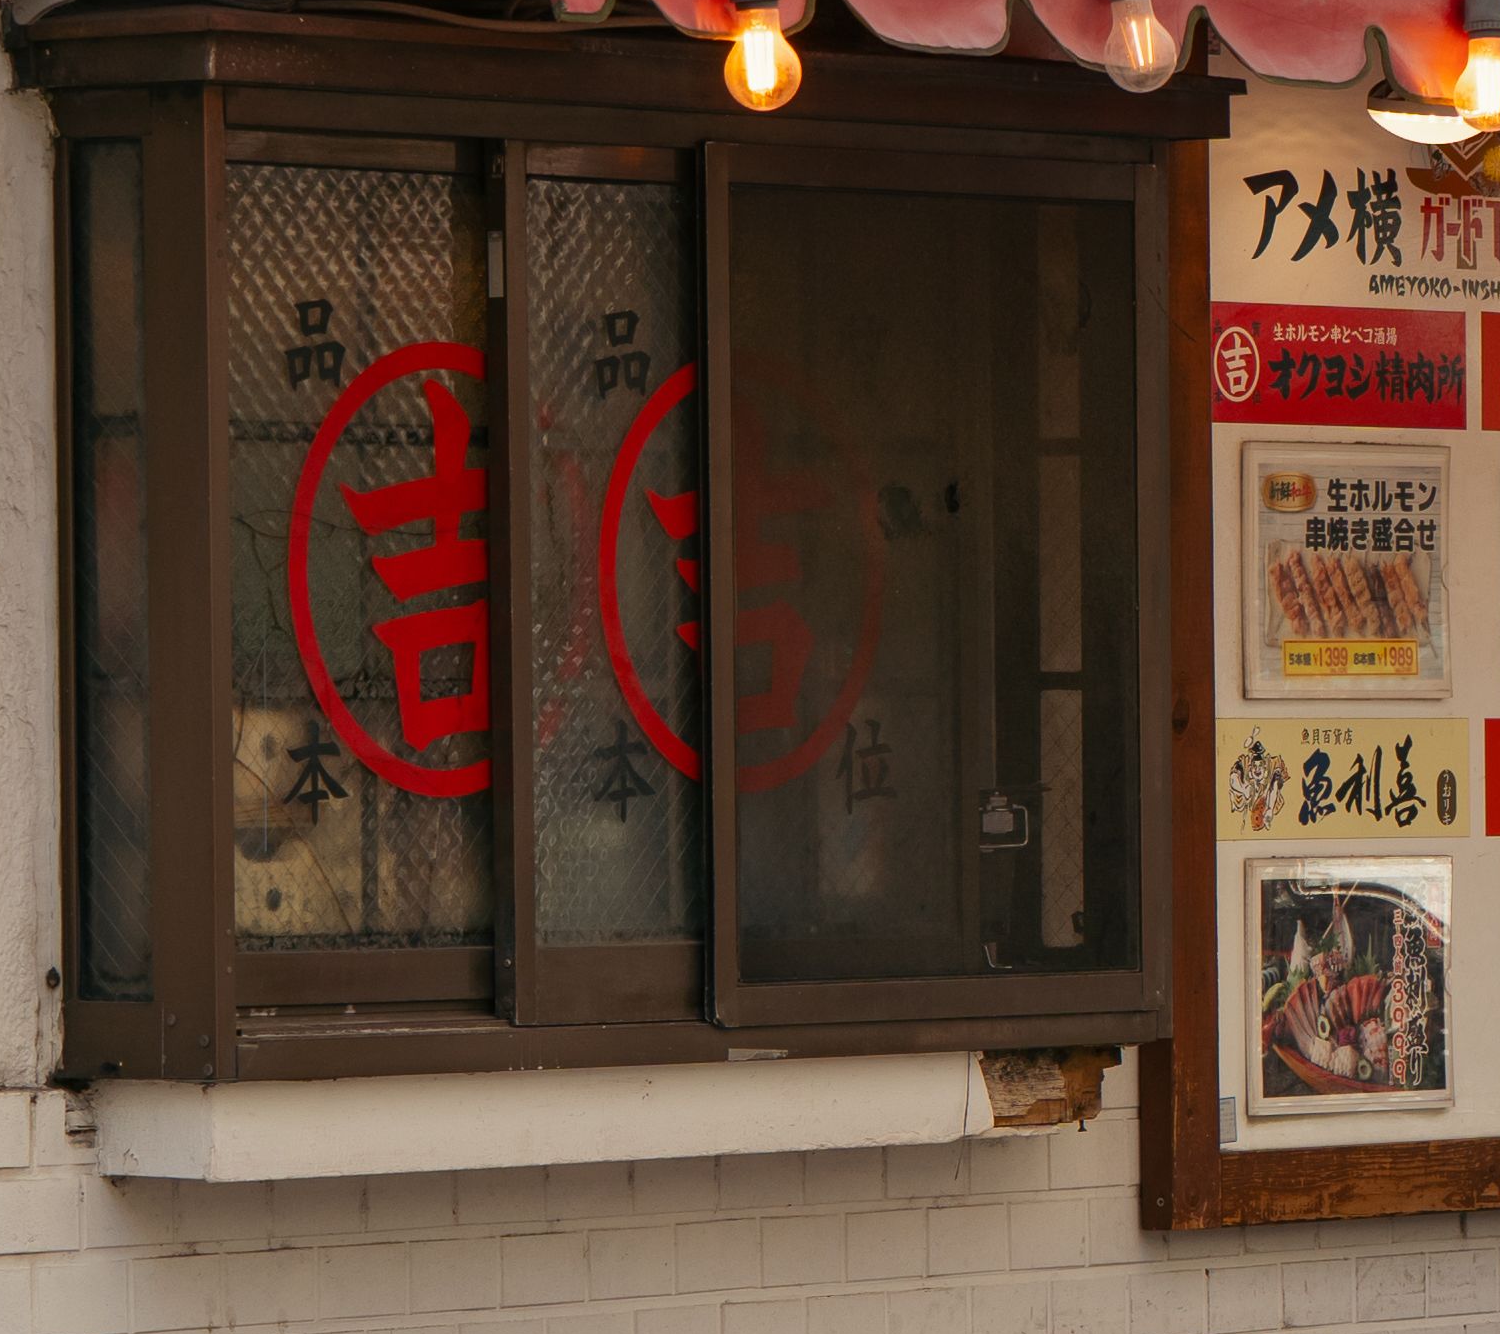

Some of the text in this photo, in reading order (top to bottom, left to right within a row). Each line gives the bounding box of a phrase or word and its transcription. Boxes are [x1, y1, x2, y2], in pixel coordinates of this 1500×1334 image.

[1242, 167, 1403, 267] アメ横
[284, 297, 347, 390] 品
[593, 308, 651, 399] 品
[1220, 332, 1253, 396] 吉
[1267, 347, 1465, 405] オクヨシ精肉所
[1305, 517, 1437, 552] 串焼き盛合せ
[1327, 478, 1437, 513] 生ホルモン
[282, 721, 350, 824] 本
[591, 719, 655, 824] 本
